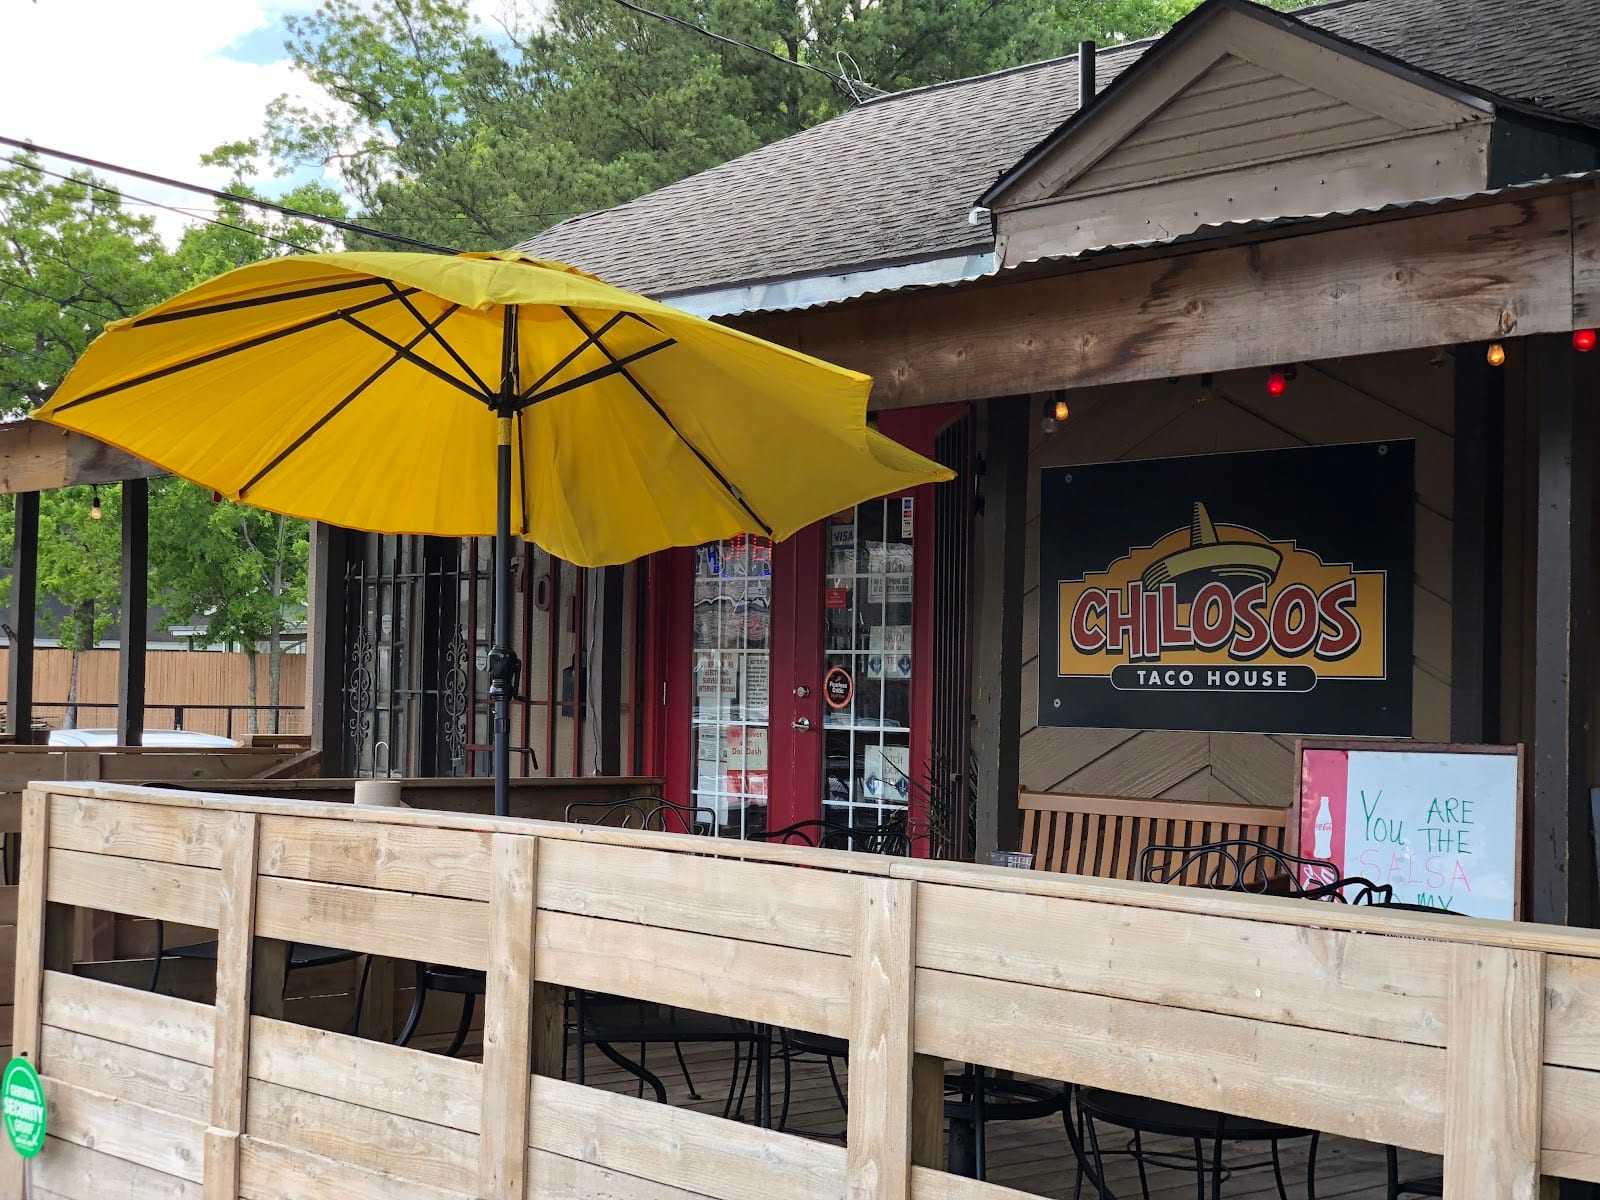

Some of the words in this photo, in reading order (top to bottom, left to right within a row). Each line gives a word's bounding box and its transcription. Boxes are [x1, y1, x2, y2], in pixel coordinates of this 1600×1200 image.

[833, 530, 854, 541] VISA
[1071, 579, 1361, 659] CHILOSOS
[1136, 670, 1195, 687] TACO
[1207, 670, 1288, 688] HOUSE
[1426, 796, 1475, 825] ARE
[1417, 827, 1473, 855] THE
[1359, 848, 1472, 893] SALSA
[4, 1096, 44, 1124] SECURITY
